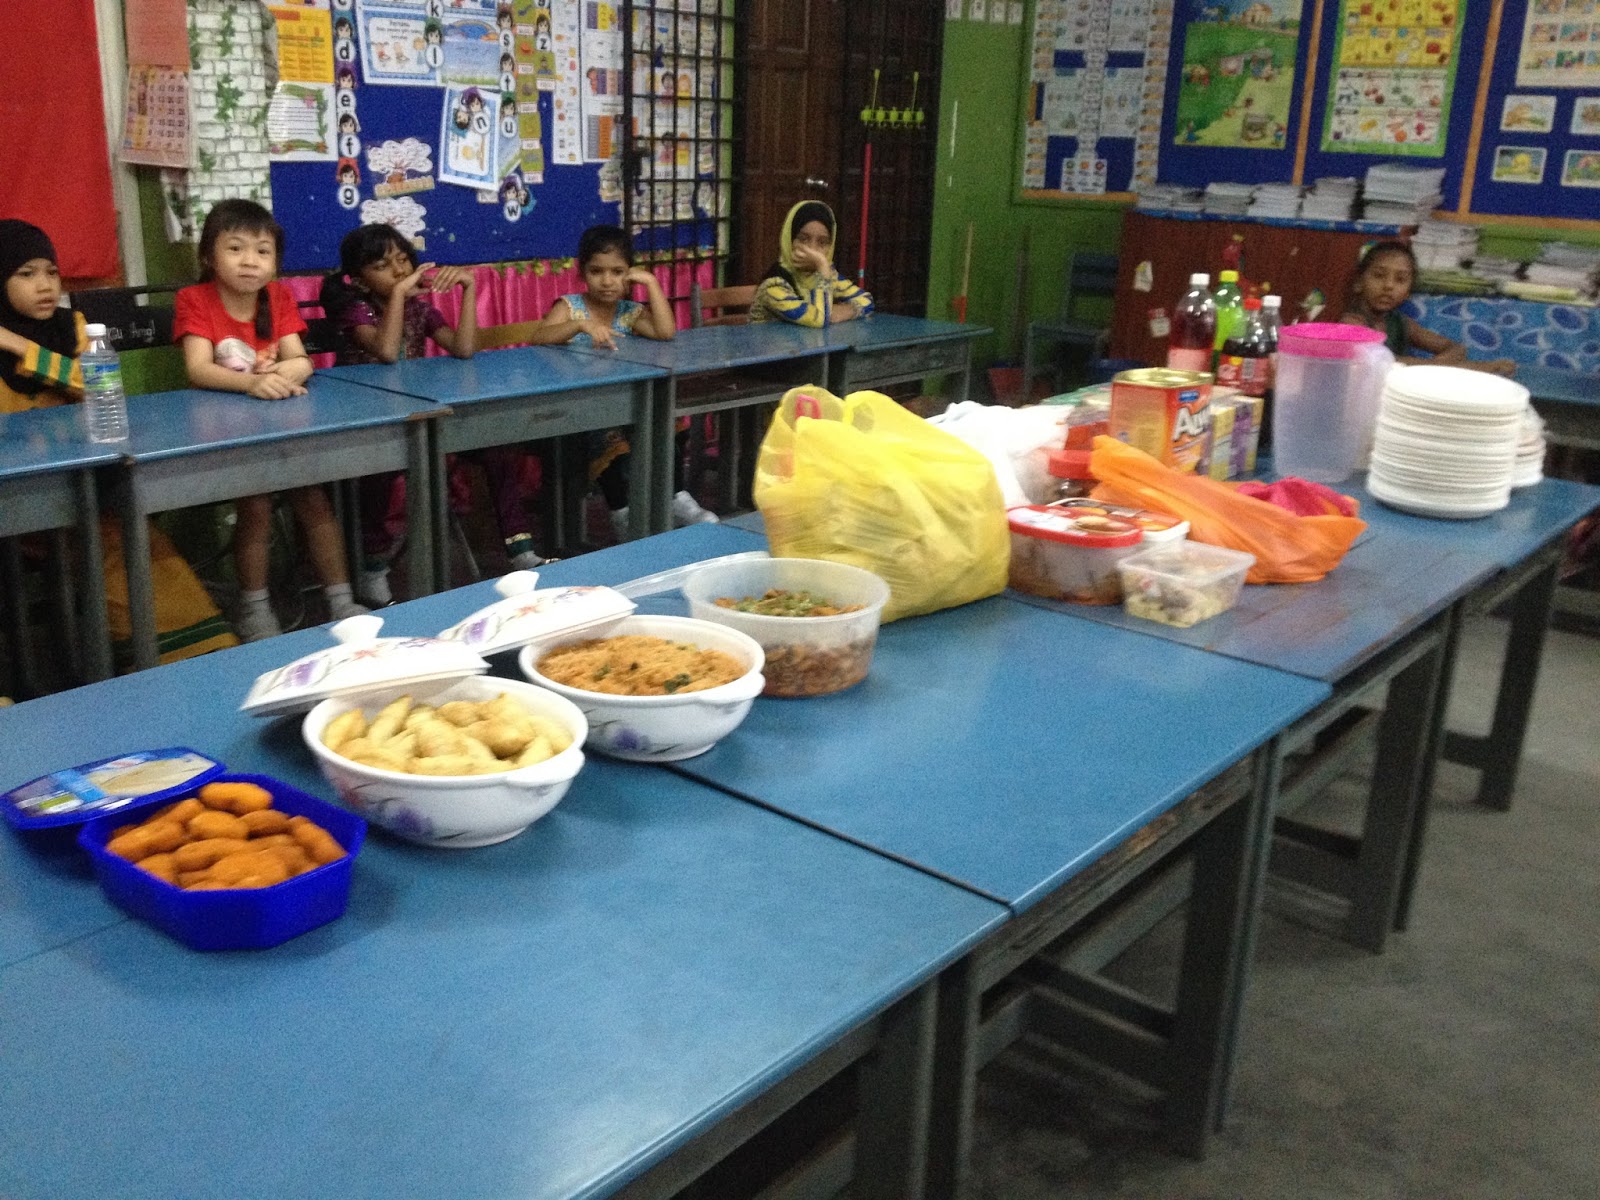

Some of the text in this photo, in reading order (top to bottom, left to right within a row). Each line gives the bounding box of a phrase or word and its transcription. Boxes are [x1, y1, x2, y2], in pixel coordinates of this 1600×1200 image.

[431, 0, 440, 17] k
[339, 41, 350, 59] d
[341, 95, 351, 107] e
[476, 116, 487, 129] n
[505, 121, 513, 134] u
[346, 137, 353, 155] f
[344, 188, 354, 205] g
[507, 205, 518, 217] w
